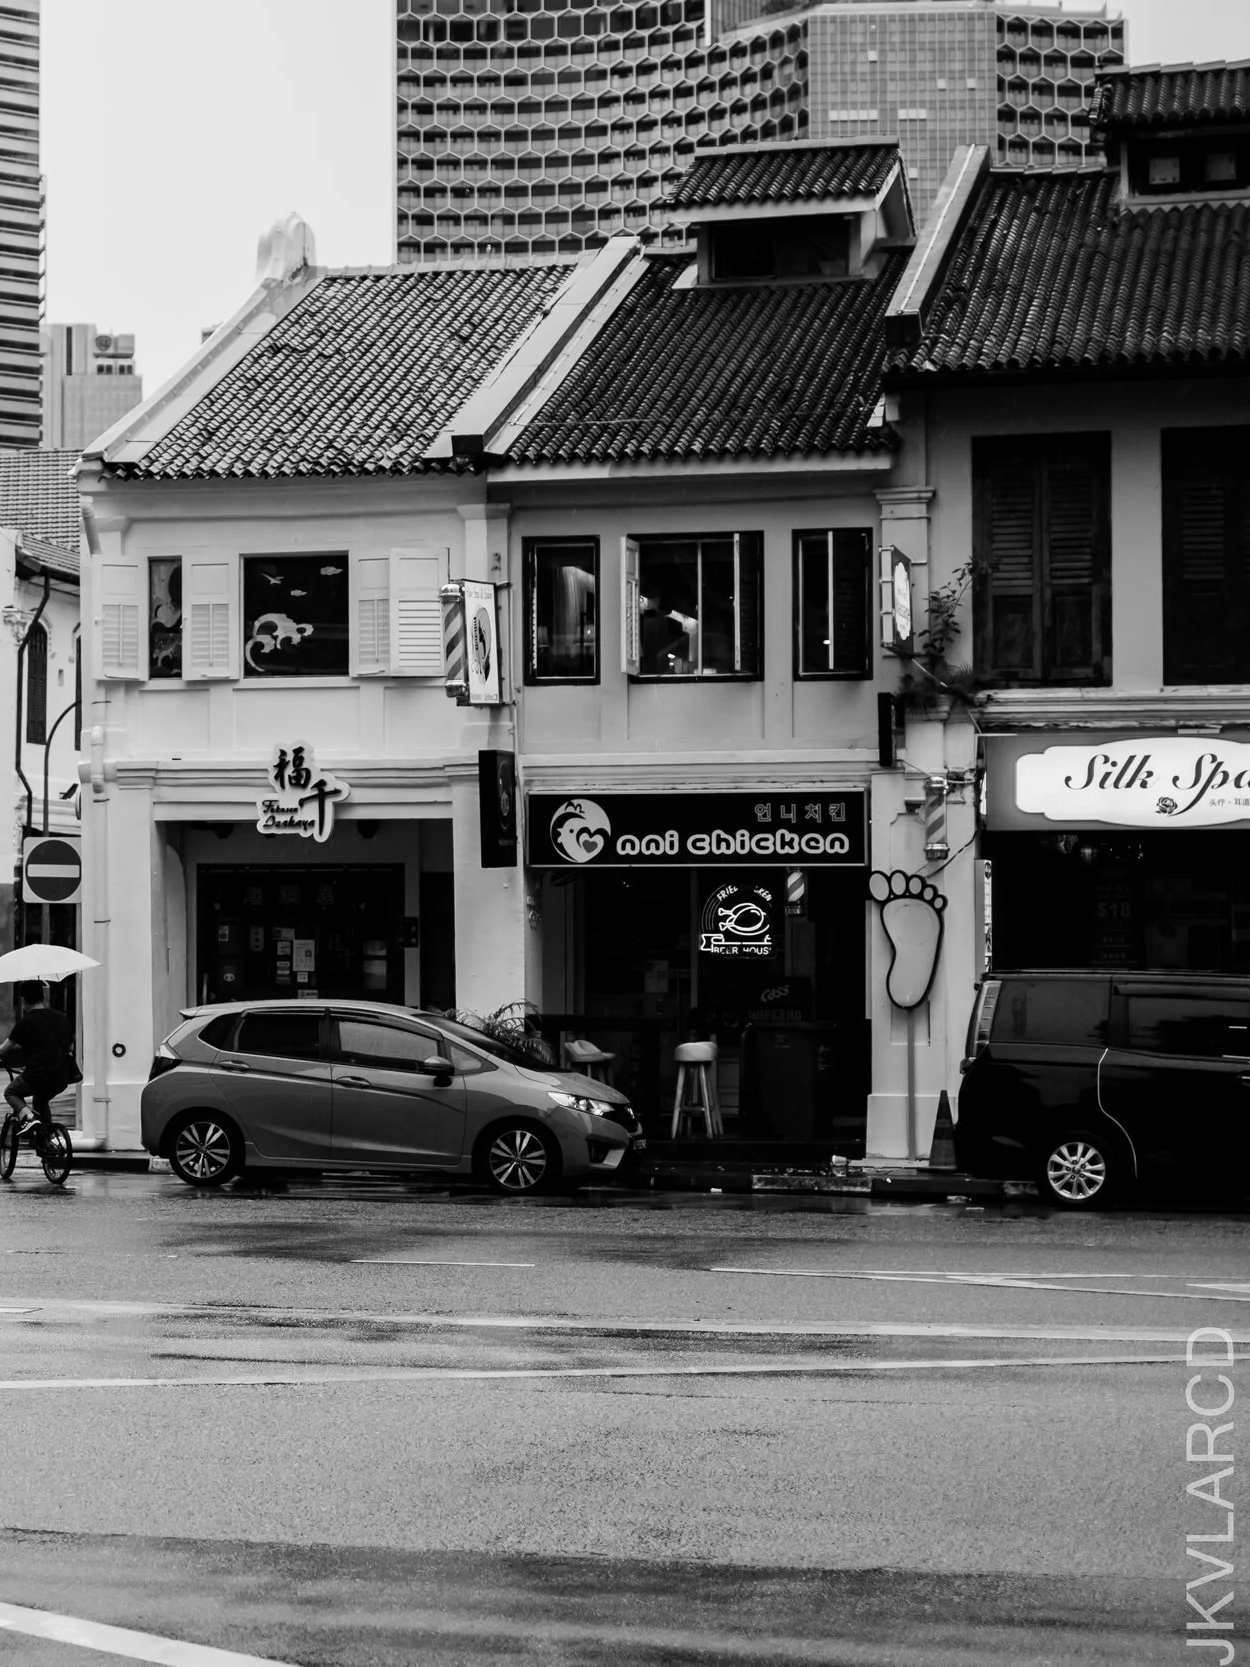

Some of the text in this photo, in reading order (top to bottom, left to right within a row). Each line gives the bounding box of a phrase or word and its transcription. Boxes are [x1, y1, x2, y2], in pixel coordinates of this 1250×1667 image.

[1064, 753, 1156, 790] Silk
[263, 815, 315, 831] Izakaya
[754, 802, 846, 823] 언니치킨
[686, 828, 850, 855] chicken
